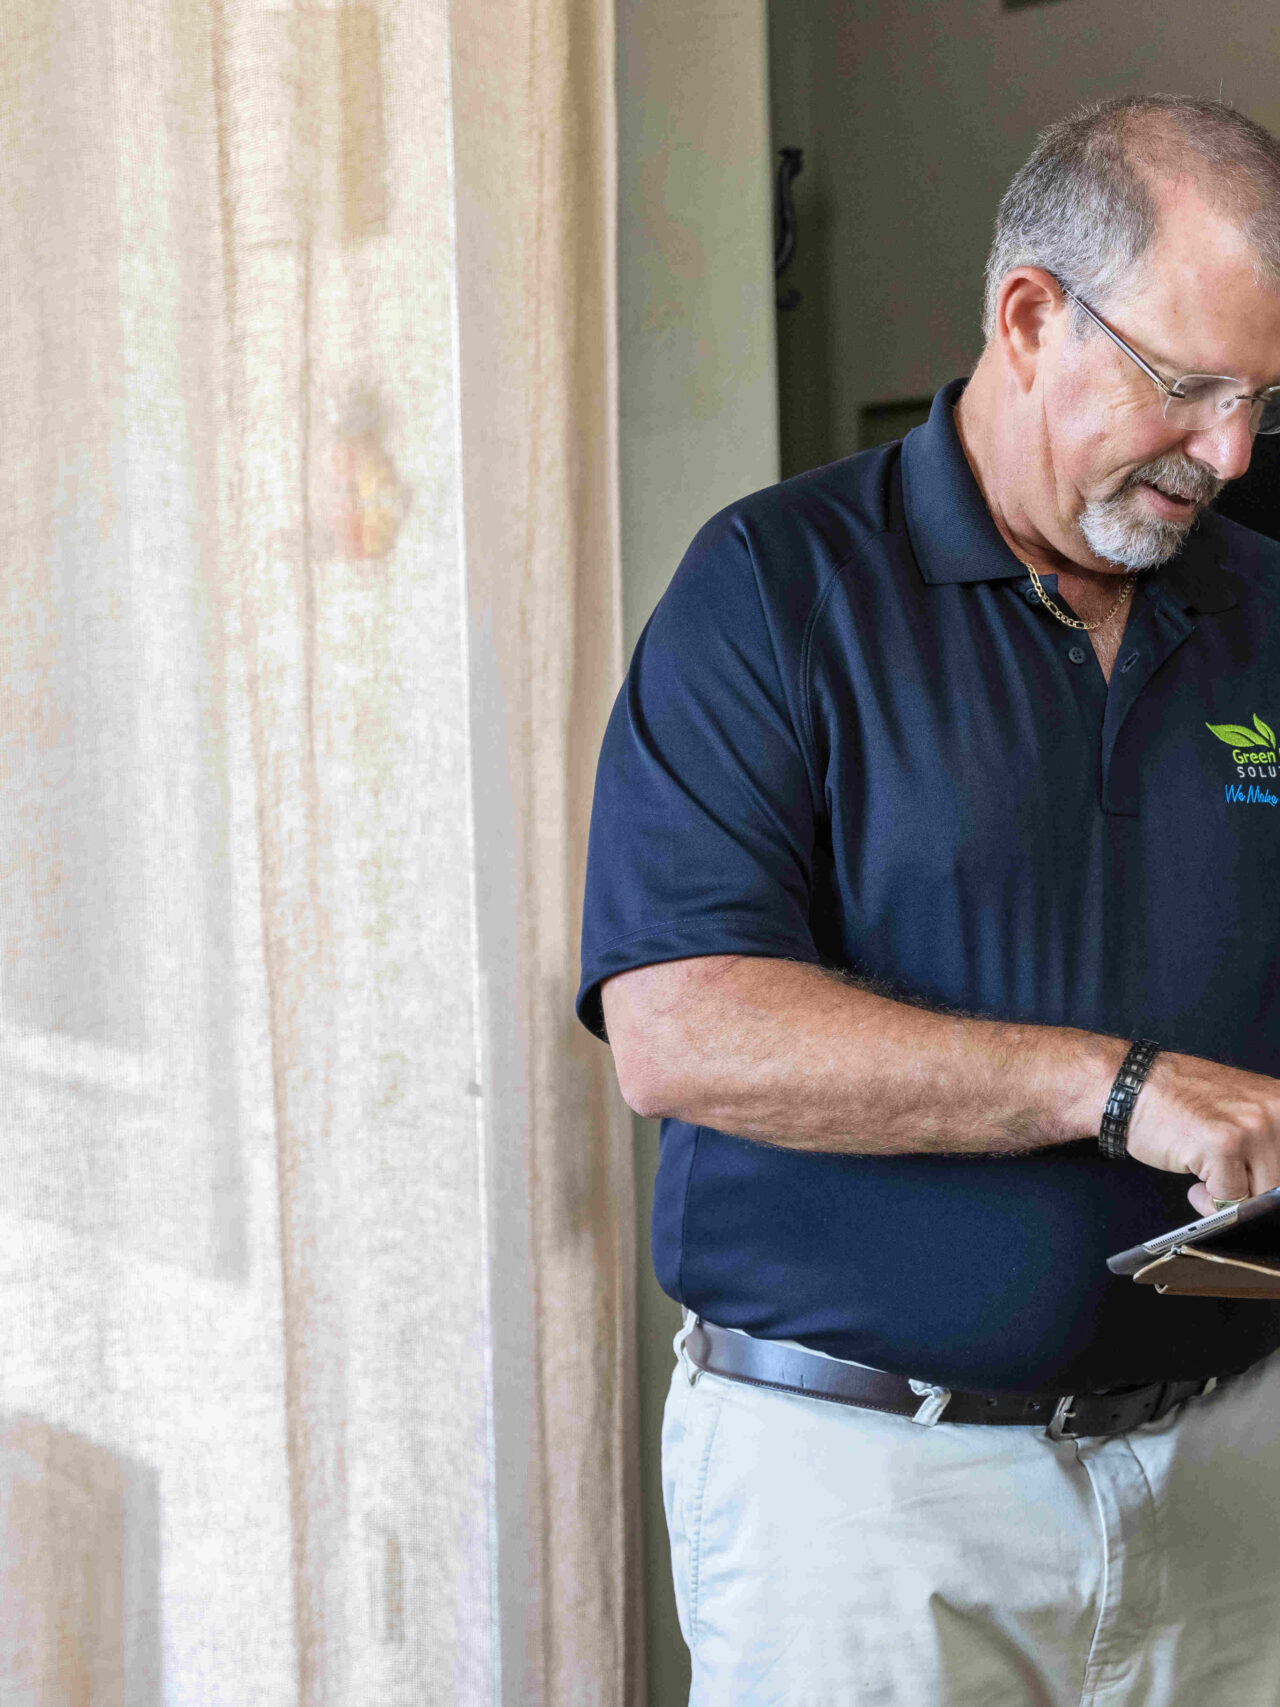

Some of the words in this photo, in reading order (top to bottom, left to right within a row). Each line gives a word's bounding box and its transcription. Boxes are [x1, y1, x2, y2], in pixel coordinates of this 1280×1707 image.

[1232, 749, 1276, 765] Green
[1225, 783, 1246, 804] We
[1246, 784, 1279, 807] Make
